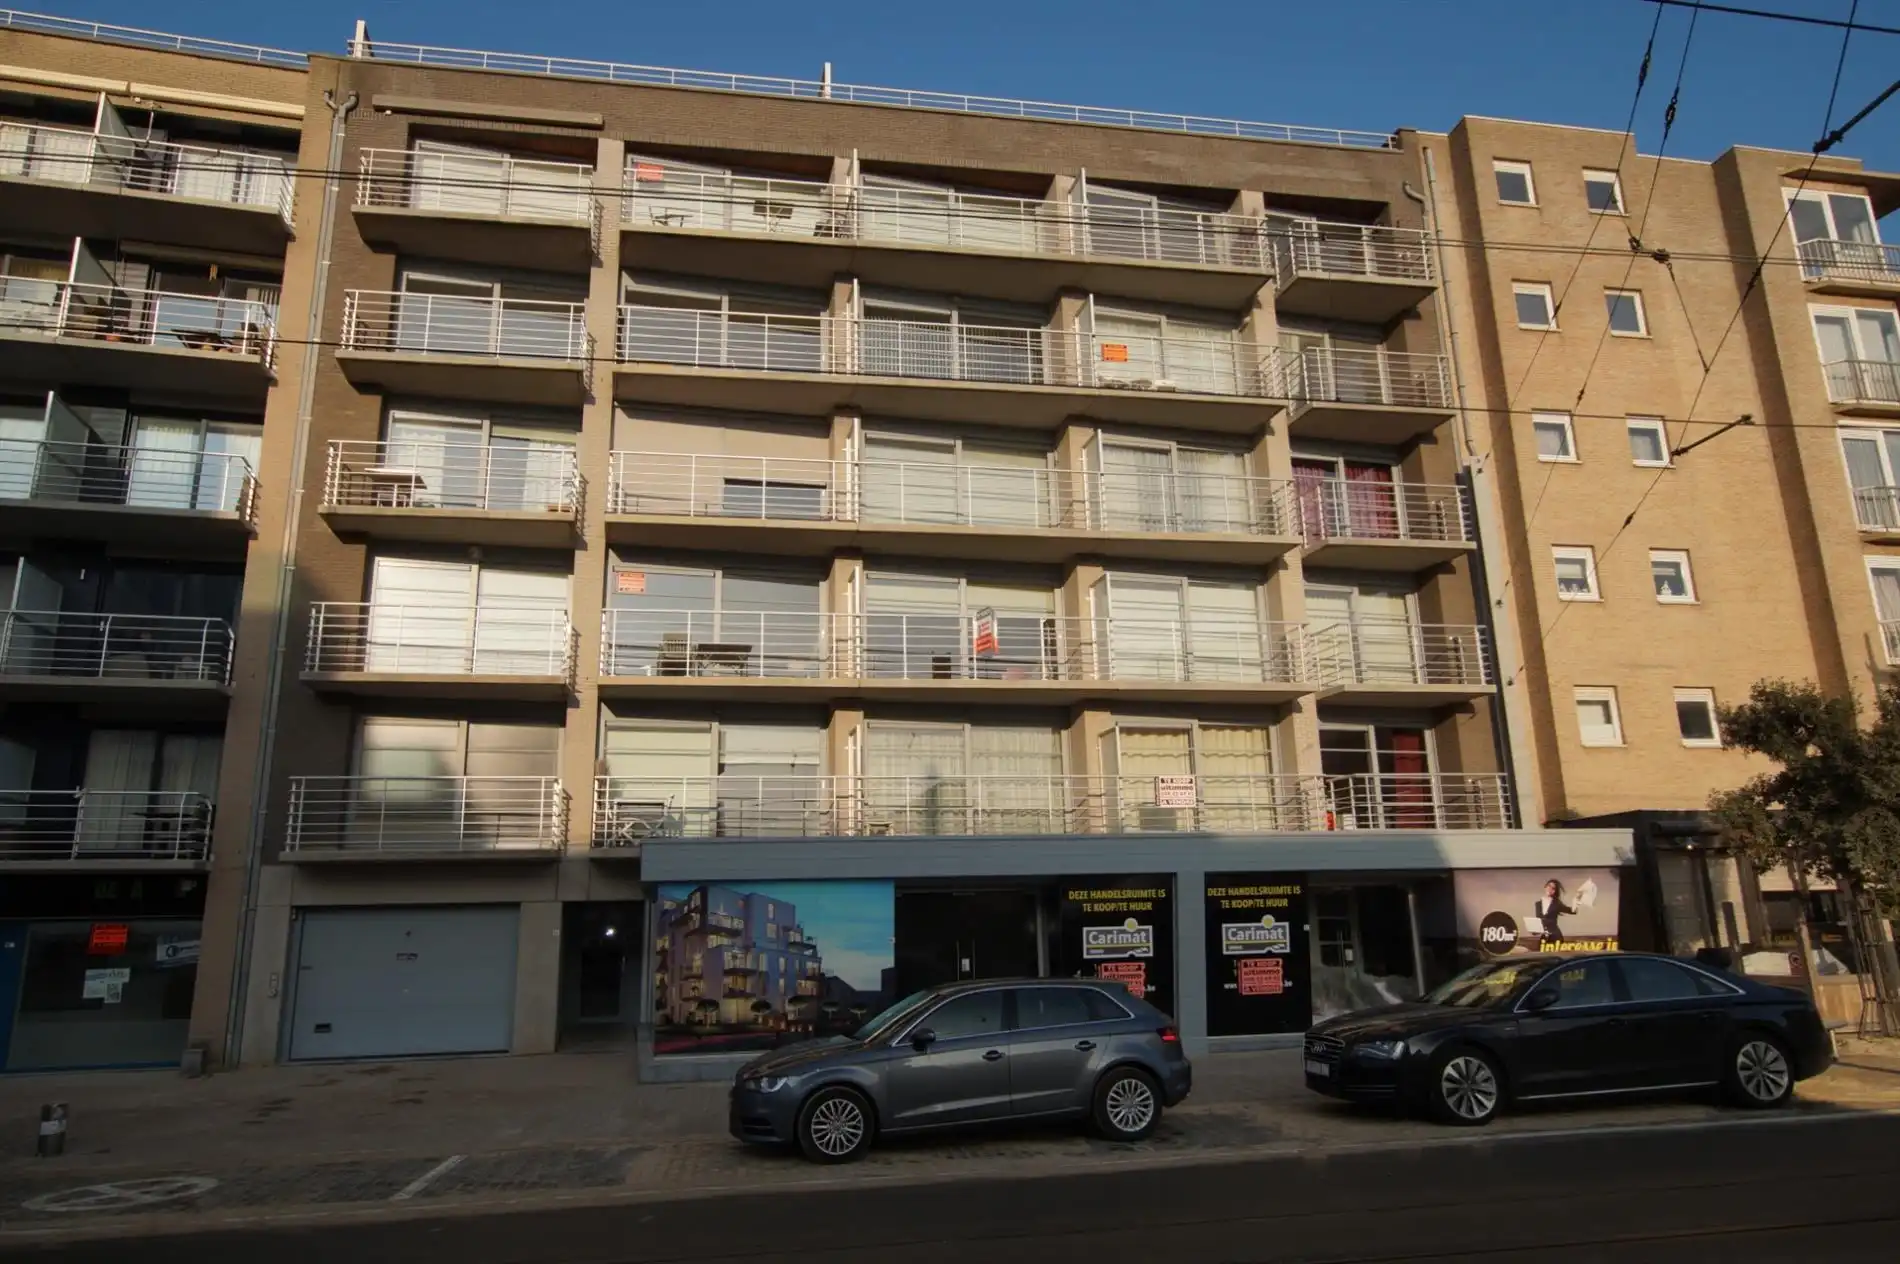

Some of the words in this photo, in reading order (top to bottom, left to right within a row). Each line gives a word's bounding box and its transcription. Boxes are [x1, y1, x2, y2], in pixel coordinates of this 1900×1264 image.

[1069, 890, 1088, 900] DEZE
[1090, 889, 1157, 899] HANDELSRUIMTE
[1158, 889, 1166, 898] IS
[1207, 887, 1226, 896] DEZE
[1228, 886, 1292, 896] HANDELSRUIMTE
[1293, 886, 1301, 894] IS
[1082, 903, 1091, 912] TE
[1129, 902, 1152, 911] HUUR
[1220, 900, 1230, 908] TE
[1265, 898, 1288, 907] HUUR
[1088, 930, 1147, 944] Carimat
[1228, 926, 1284, 940] Carimat
[1540, 939, 1602, 952] interesse
